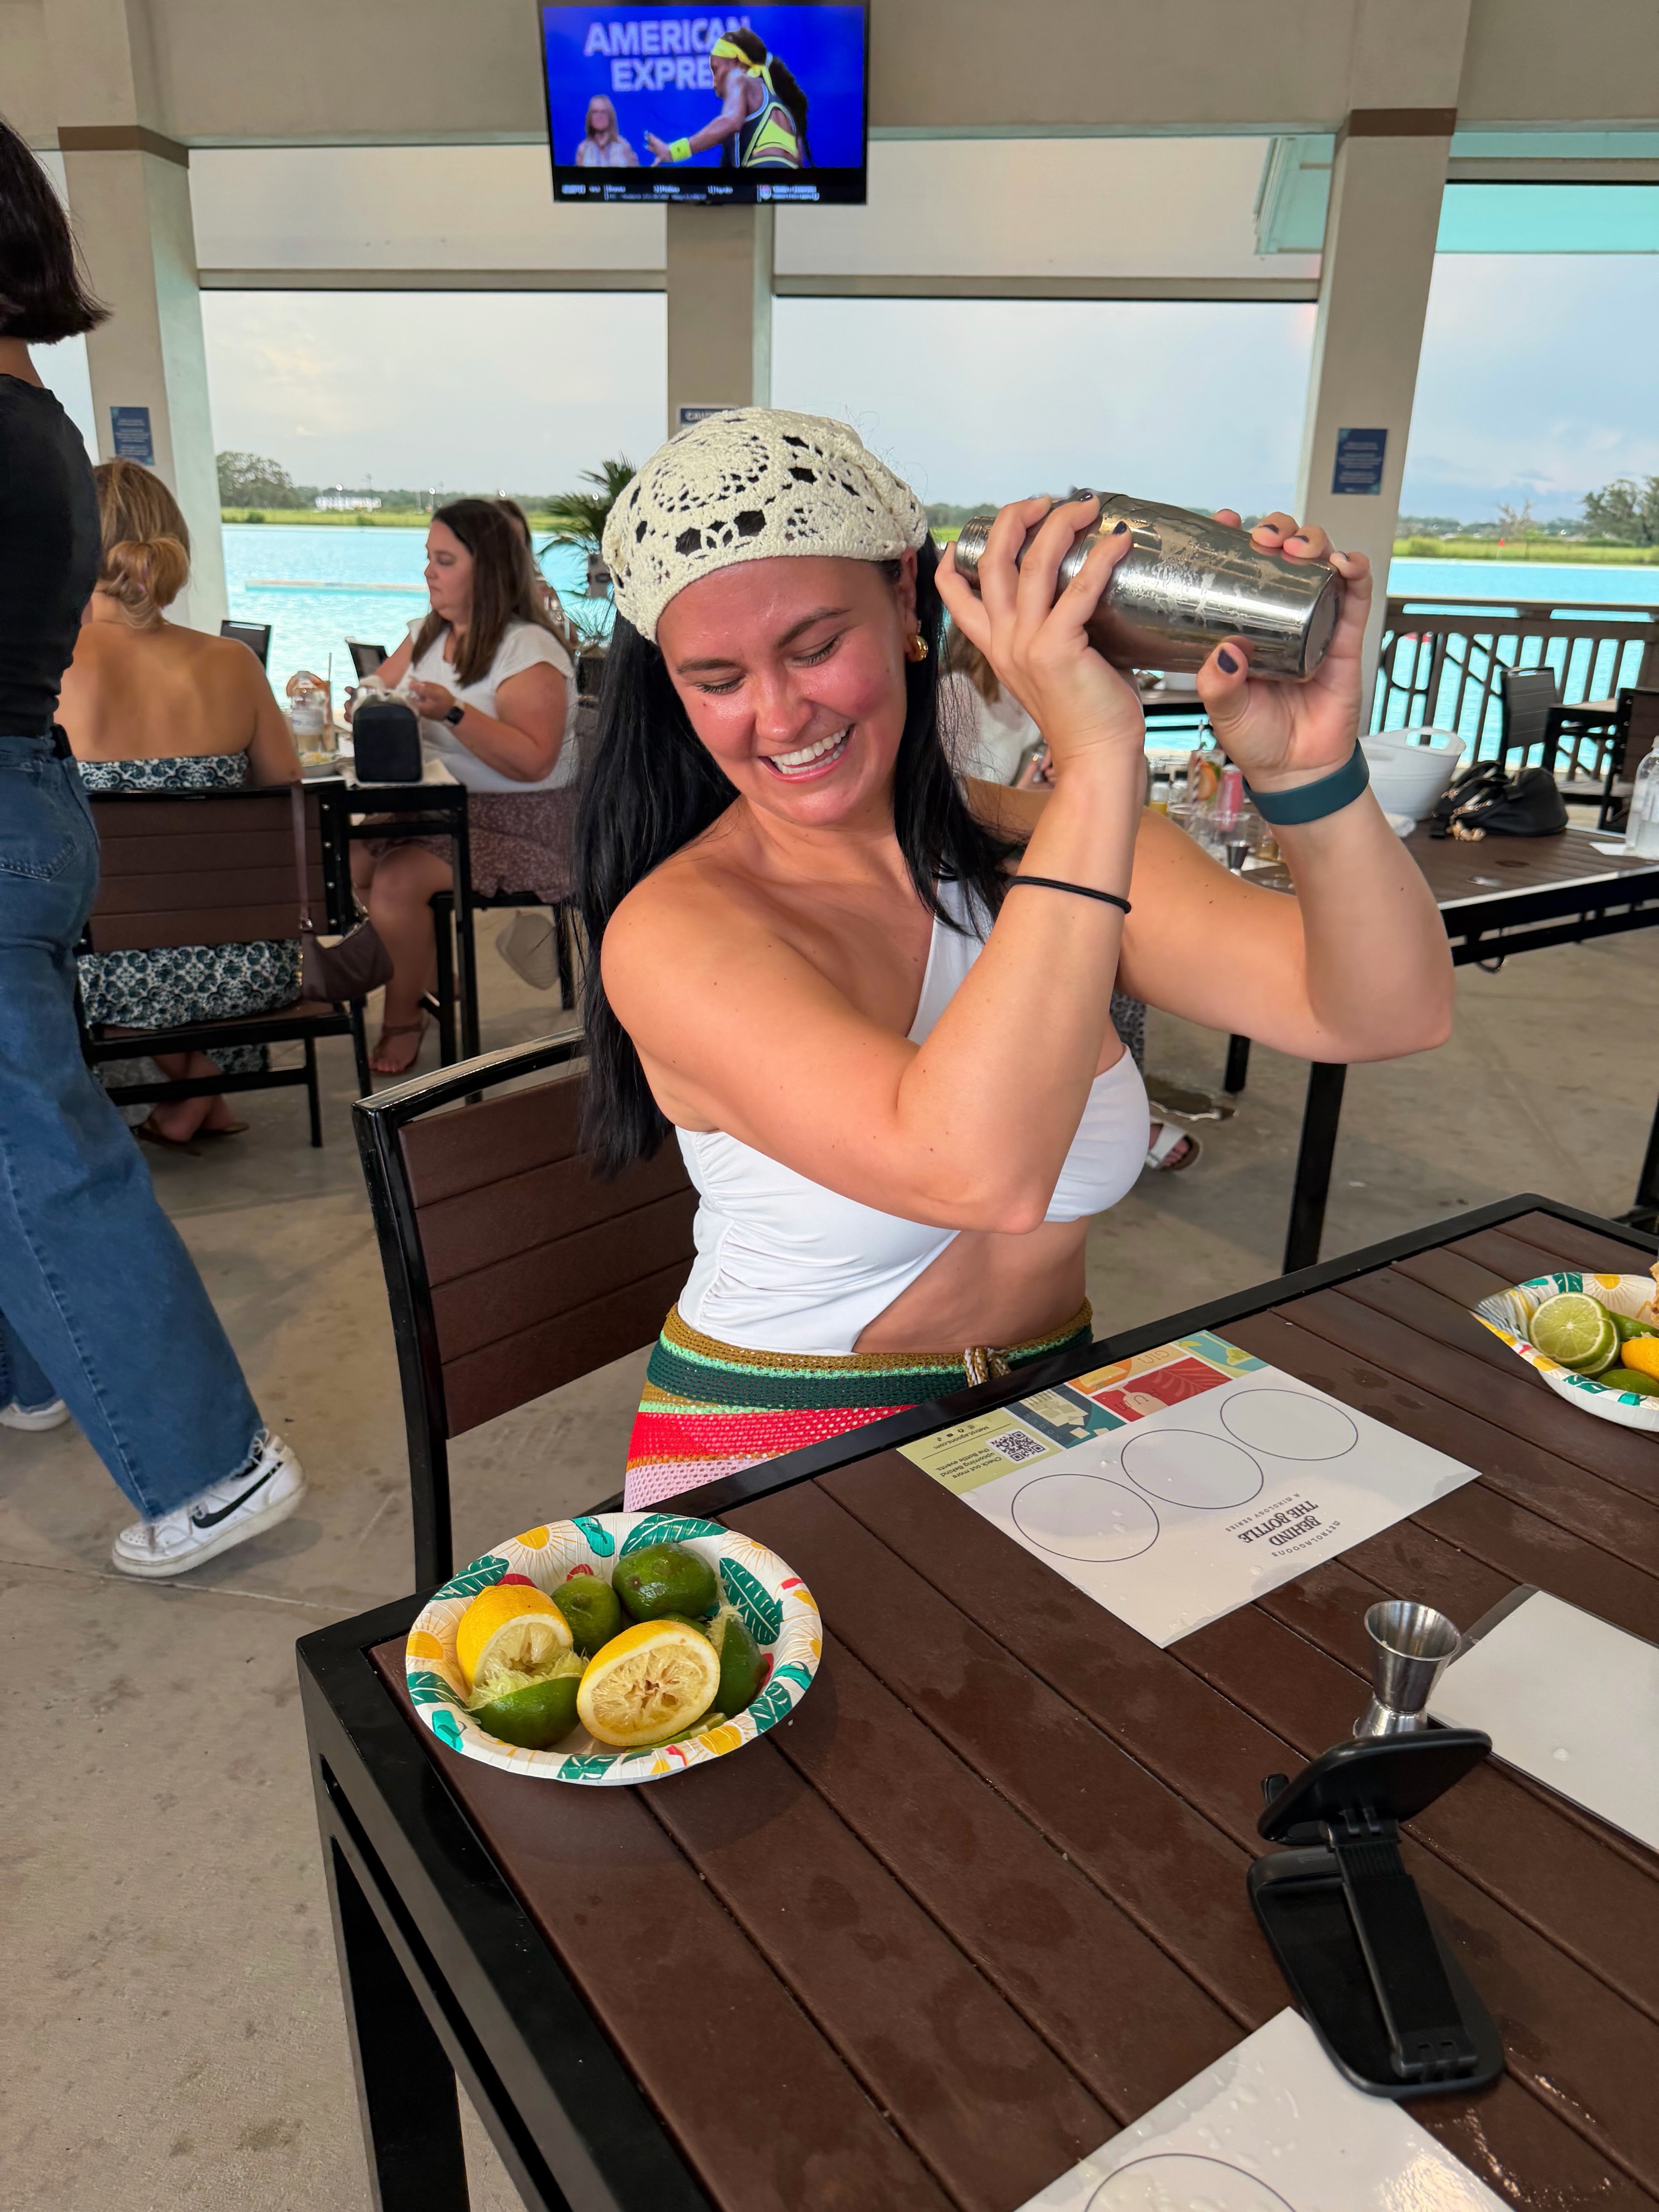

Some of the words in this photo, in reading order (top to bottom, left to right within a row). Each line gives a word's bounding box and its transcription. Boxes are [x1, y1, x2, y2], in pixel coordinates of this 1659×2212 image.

[959, 1453, 979, 1462] Bottle
[962, 1452, 995, 1467] upcoming
[981, 1456, 1002, 1466] Check
[940, 1465, 965, 1477] Behind
[952, 1469, 970, 1479] more
[1286, 1500, 1319, 1519] THE
[1225, 1517, 1253, 1532] SERIES
[1237, 1512, 1292, 1543] BOTTLE
[1268, 1515, 1322, 1546] BEHIND
